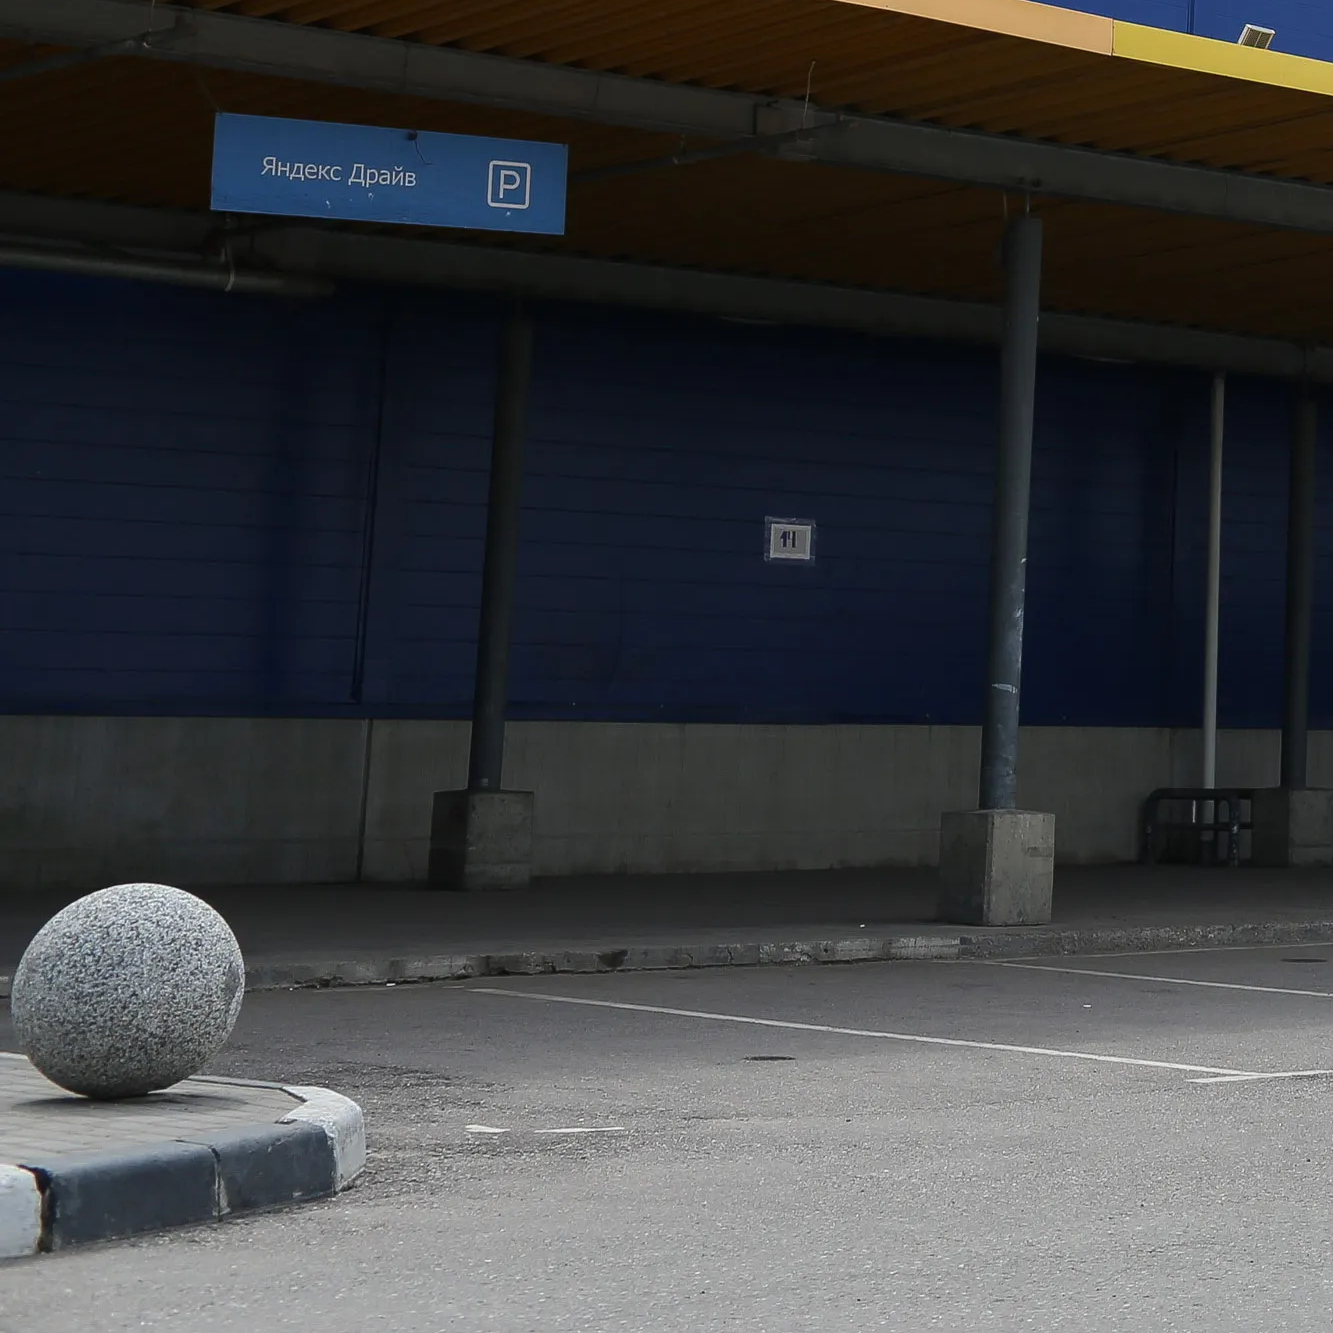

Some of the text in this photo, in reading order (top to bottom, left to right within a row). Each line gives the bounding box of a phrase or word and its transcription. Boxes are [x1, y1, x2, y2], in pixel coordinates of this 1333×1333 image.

[260, 156, 417, 188] Яндекс Драйв
[498, 169, 521, 200] P
